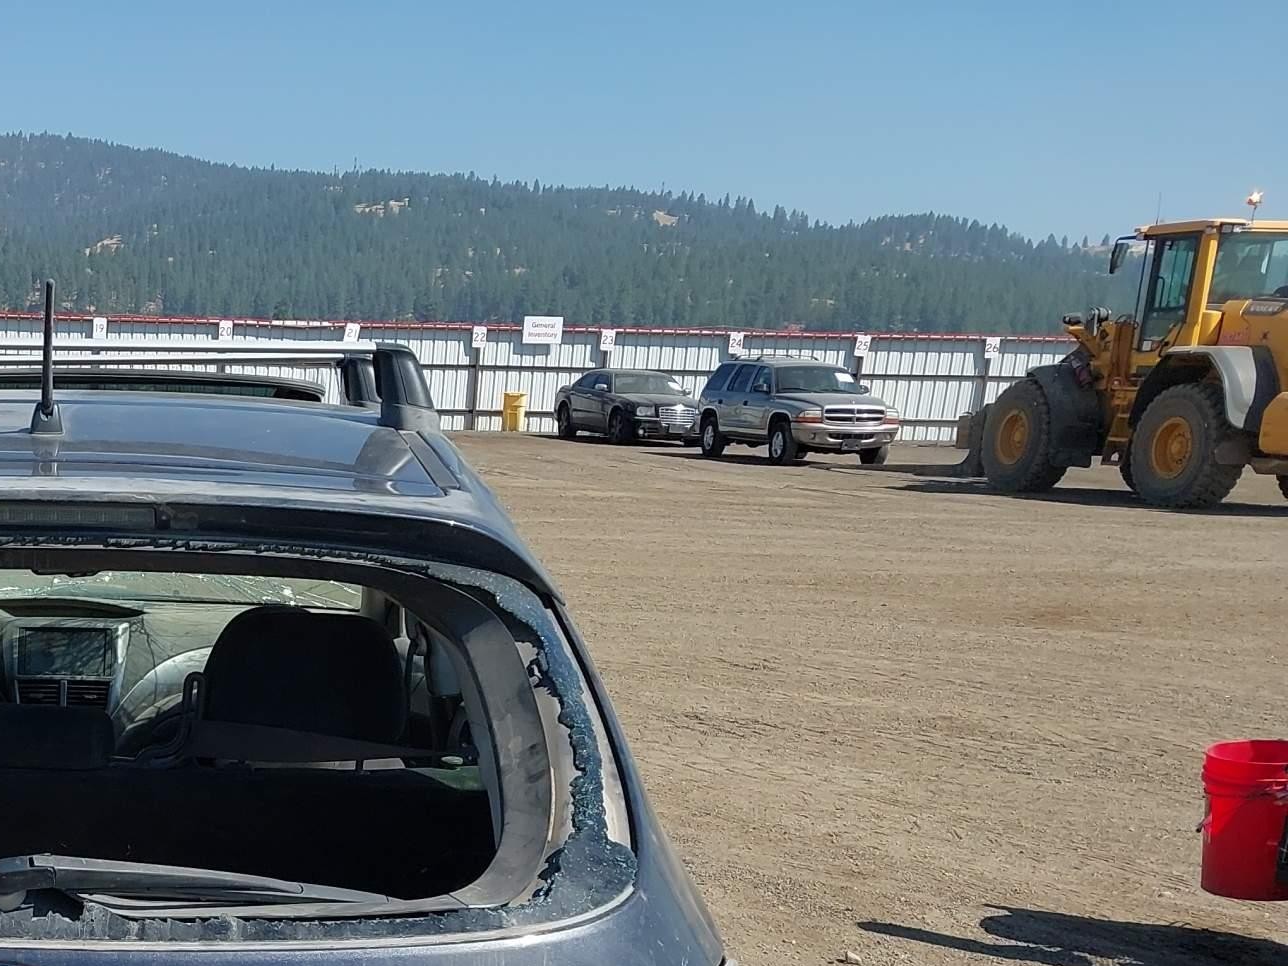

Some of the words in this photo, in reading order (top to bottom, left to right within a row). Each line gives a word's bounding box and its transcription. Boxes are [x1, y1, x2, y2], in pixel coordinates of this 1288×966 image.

[95, 323, 105, 333] 19
[531, 321, 557, 330] General
[219, 326, 232, 337] 20
[347, 327, 358, 338] 21
[473, 332, 486, 342] 22
[527, 331, 558, 339] Inventory
[601, 334, 614, 345] 23
[730, 337, 742, 349] 24
[856, 339, 869, 351] 25
[986, 342, 1000, 353] 26
